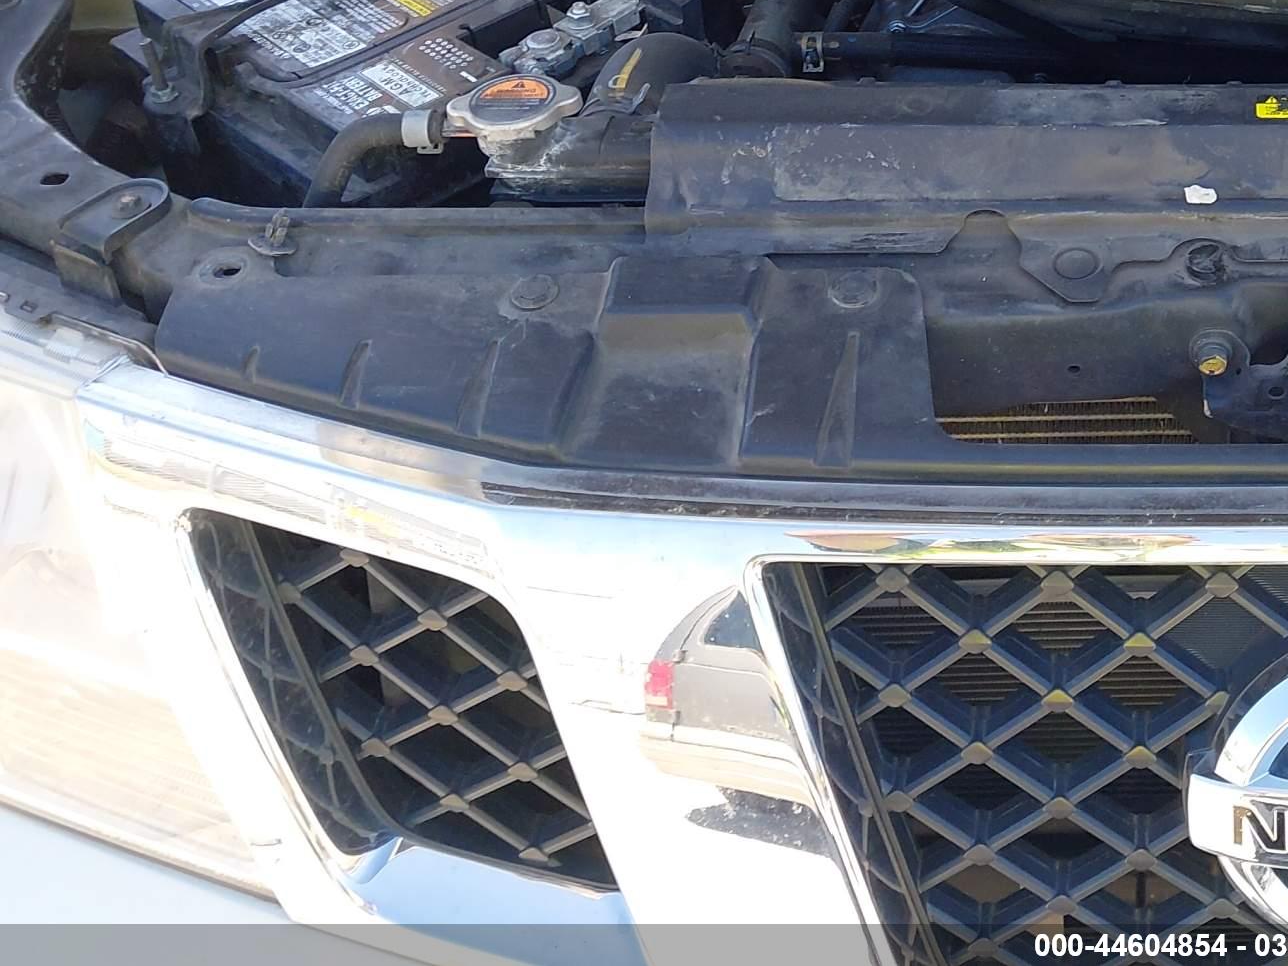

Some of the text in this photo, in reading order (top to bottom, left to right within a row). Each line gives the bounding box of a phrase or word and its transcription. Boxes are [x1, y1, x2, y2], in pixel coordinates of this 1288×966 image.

[340, 75, 384, 101] BATTERY
[381, 64, 433, 99] TECHNOLOGY
[381, 76, 411, 95] AGM
